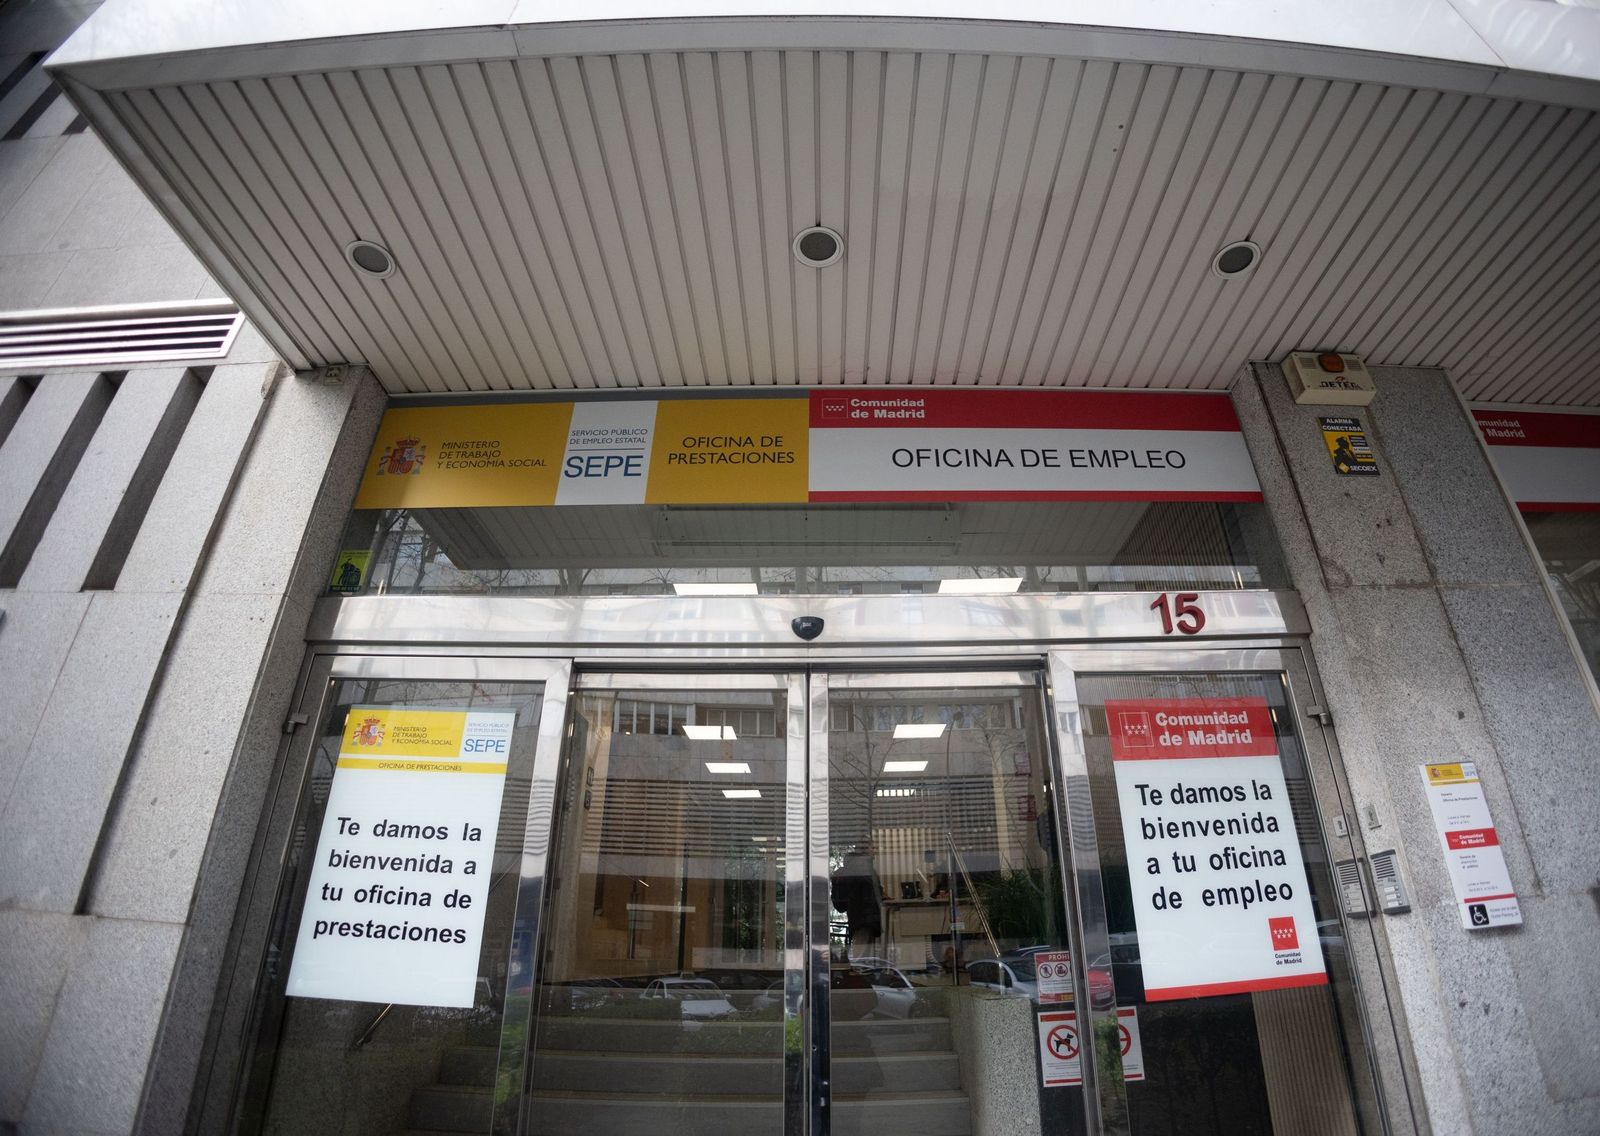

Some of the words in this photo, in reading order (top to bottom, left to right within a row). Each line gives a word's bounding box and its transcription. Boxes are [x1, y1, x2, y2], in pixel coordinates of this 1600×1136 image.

[850, 398, 925, 407] Comunidad
[851, 409, 871, 418] de
[874, 408, 926, 418] Madrid
[571, 429, 609, 437] SERVICIO
[582, 437, 613, 445] EMPLEO
[1487, 428, 1526, 438] Madrid
[441, 440, 501, 449] MINISTERIO
[682, 436, 755, 448] OFICINA
[760, 436, 784, 447] DE
[439, 451, 454, 460] DE
[455, 450, 501, 459] TRABAJO
[668, 451, 795, 465] PRESTACIONES
[891, 448, 1014, 469] OFICINA
[1021, 449, 1061, 468] DE
[1070, 449, 1187, 469] EMPLEO
[437, 461, 444, 469] Y
[507, 459, 548, 467] SOCIAL
[564, 455, 644, 478] SEPE
[1150, 593, 1206, 635] 15
[1155, 711, 1249, 727] Comunidad
[464, 739, 507, 753] SEPE
[1159, 731, 1183, 747] de
[1188, 729, 1253, 746] Madrid
[1134, 783, 1163, 806] Te
[1170, 782, 1247, 805] damos
[1251, 779, 1273, 801] la
[337, 817, 360, 836] Te
[373, 819, 448, 840] damos
[462, 823, 482, 842] la
[1141, 812, 1280, 840] bienvenida
[328, 849, 453, 874] bienvenida
[463, 860, 477, 875] a
[1146, 857, 1160, 875] a
[1172, 851, 1196, 873] tu
[1209, 846, 1287, 871] oficina
[321, 882, 343, 901] tu
[353, 884, 432, 907] oficina
[443, 888, 472, 909] de
[1151, 886, 1183, 911] de
[1201, 879, 1293, 910] empleo
[313, 920, 467, 943] prestaciones
